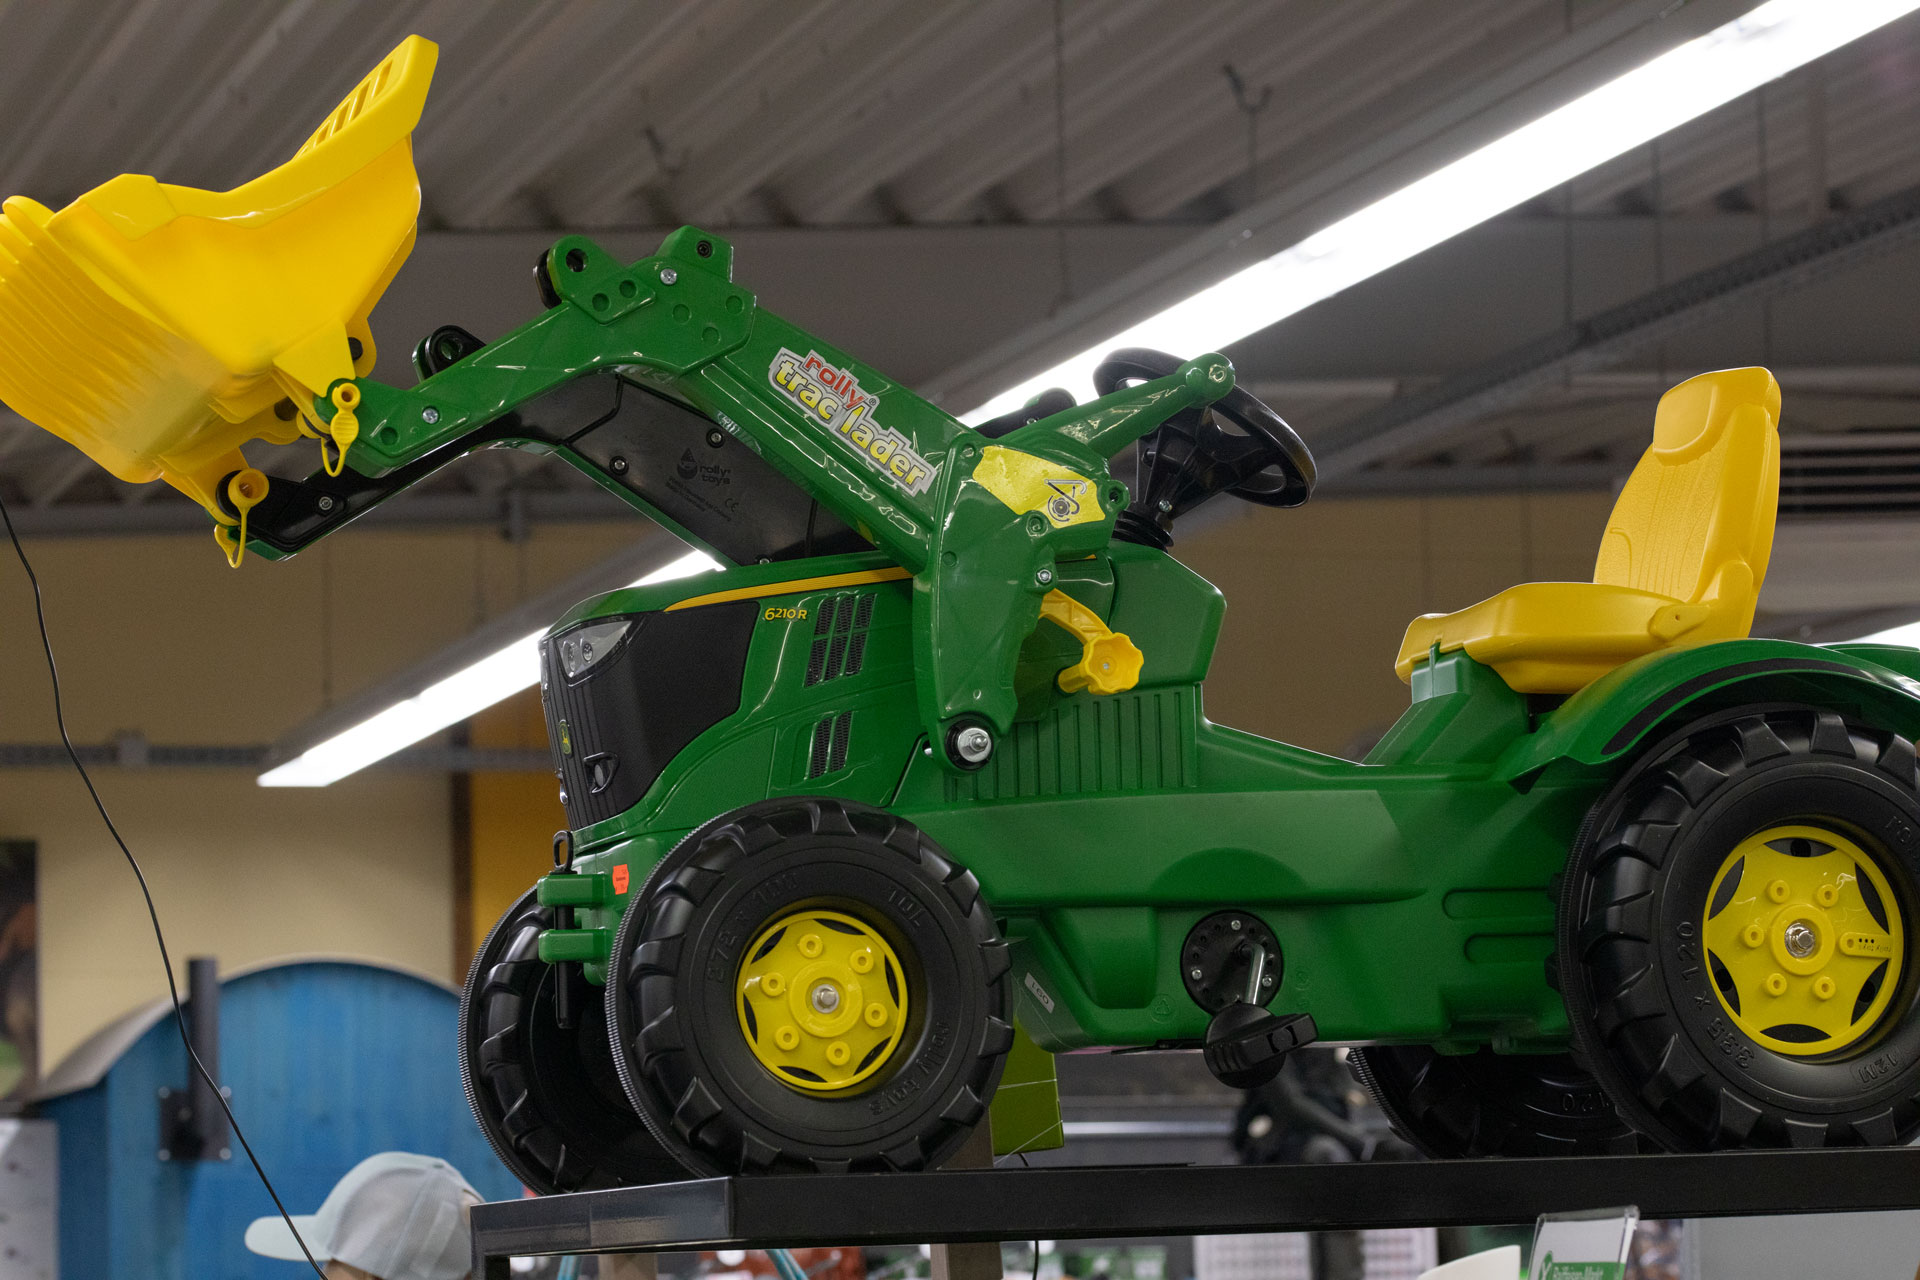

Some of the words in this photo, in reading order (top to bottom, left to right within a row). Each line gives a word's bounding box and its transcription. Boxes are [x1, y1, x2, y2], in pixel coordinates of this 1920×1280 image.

[775, 360, 839, 420] trac
[840, 405, 926, 485] lader
[1676, 921, 1700, 982] 120
[1706, 1016, 1757, 1070] 335
